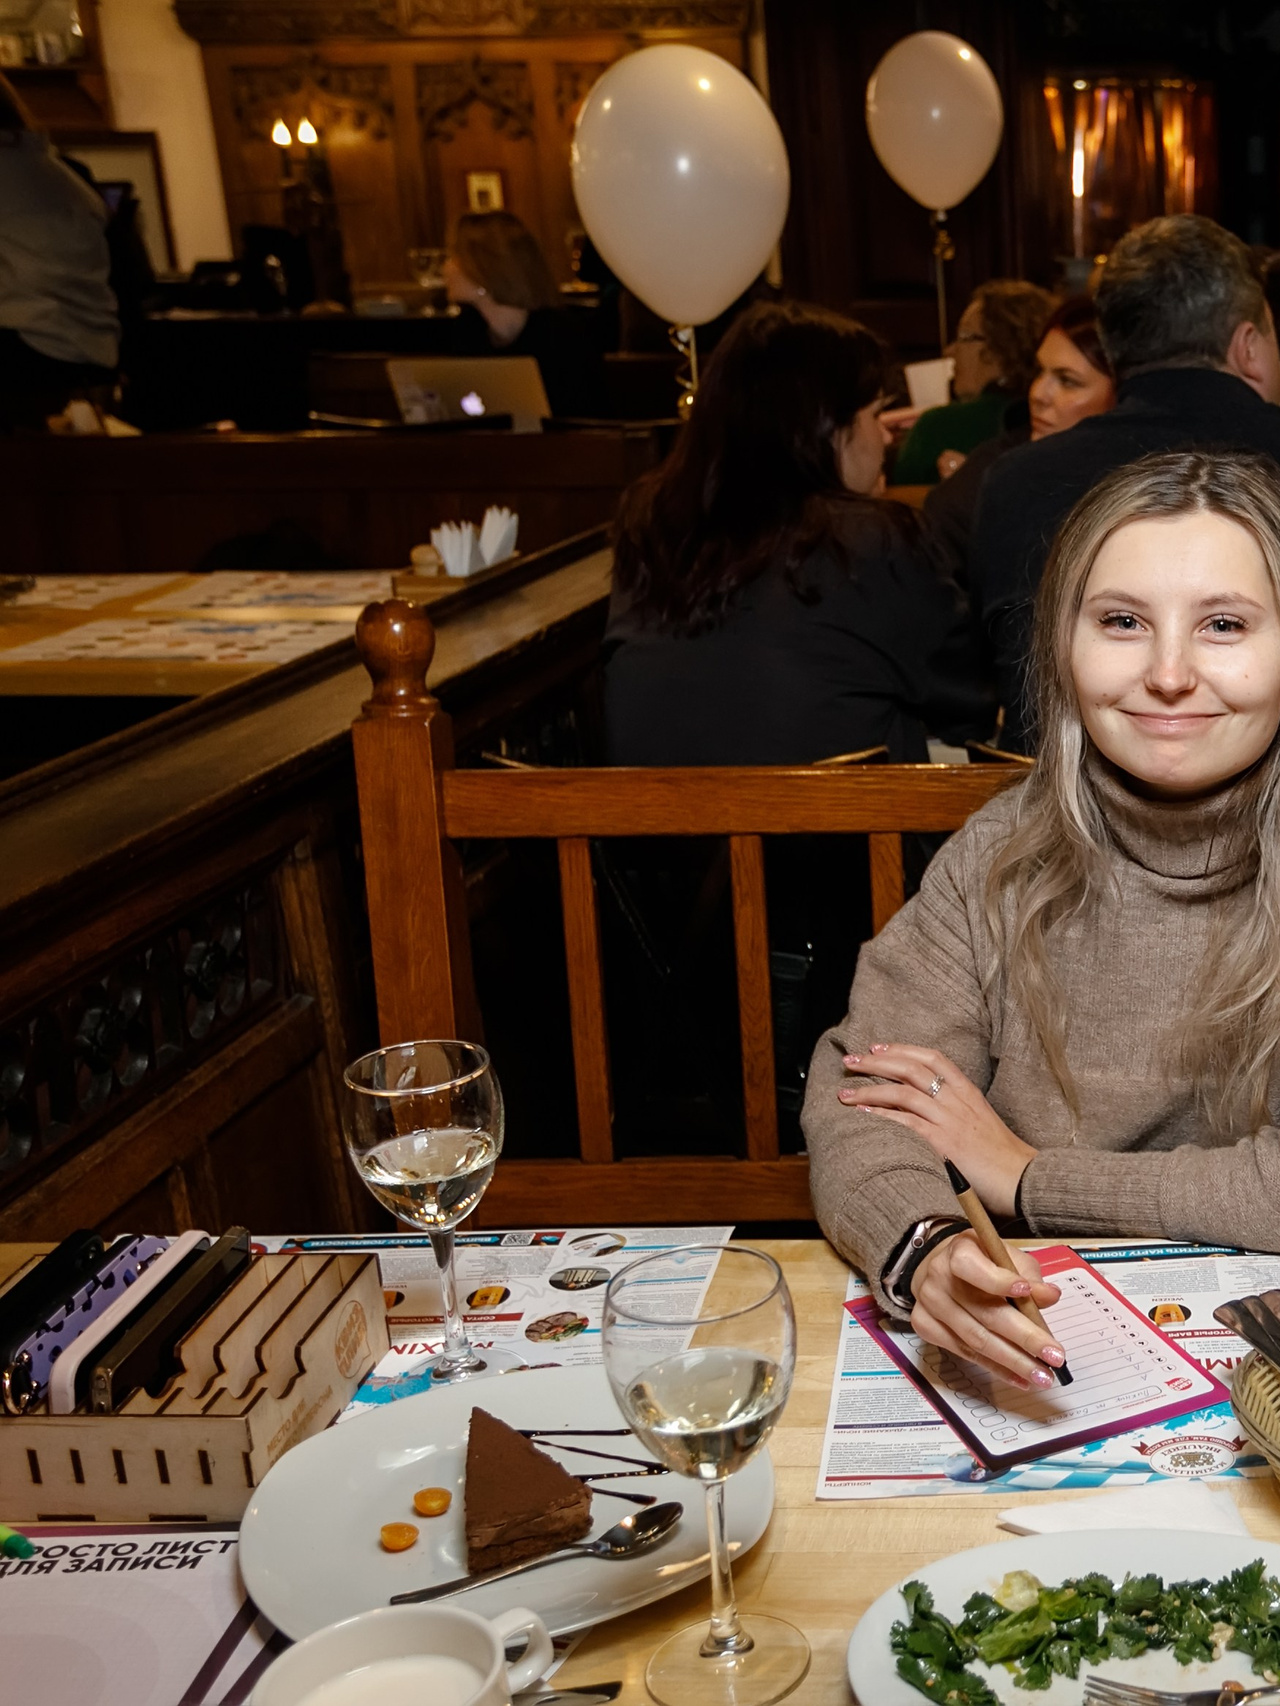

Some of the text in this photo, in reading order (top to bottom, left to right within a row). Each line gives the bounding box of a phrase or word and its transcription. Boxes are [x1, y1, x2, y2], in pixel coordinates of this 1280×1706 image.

[1078, 1251, 1126, 1260] ЛОЯЛЬН
[1129, 1248, 1163, 1257] КАРТУ
[1160, 1444, 1222, 1457] BRAUEREI
[1158, 1462, 1228, 1476] MAXIMILIAN'S
[2, 1539, 239, 1560] РОСТО ЛИСТ
[62, 1554, 205, 1574] ЗАПИСИ
